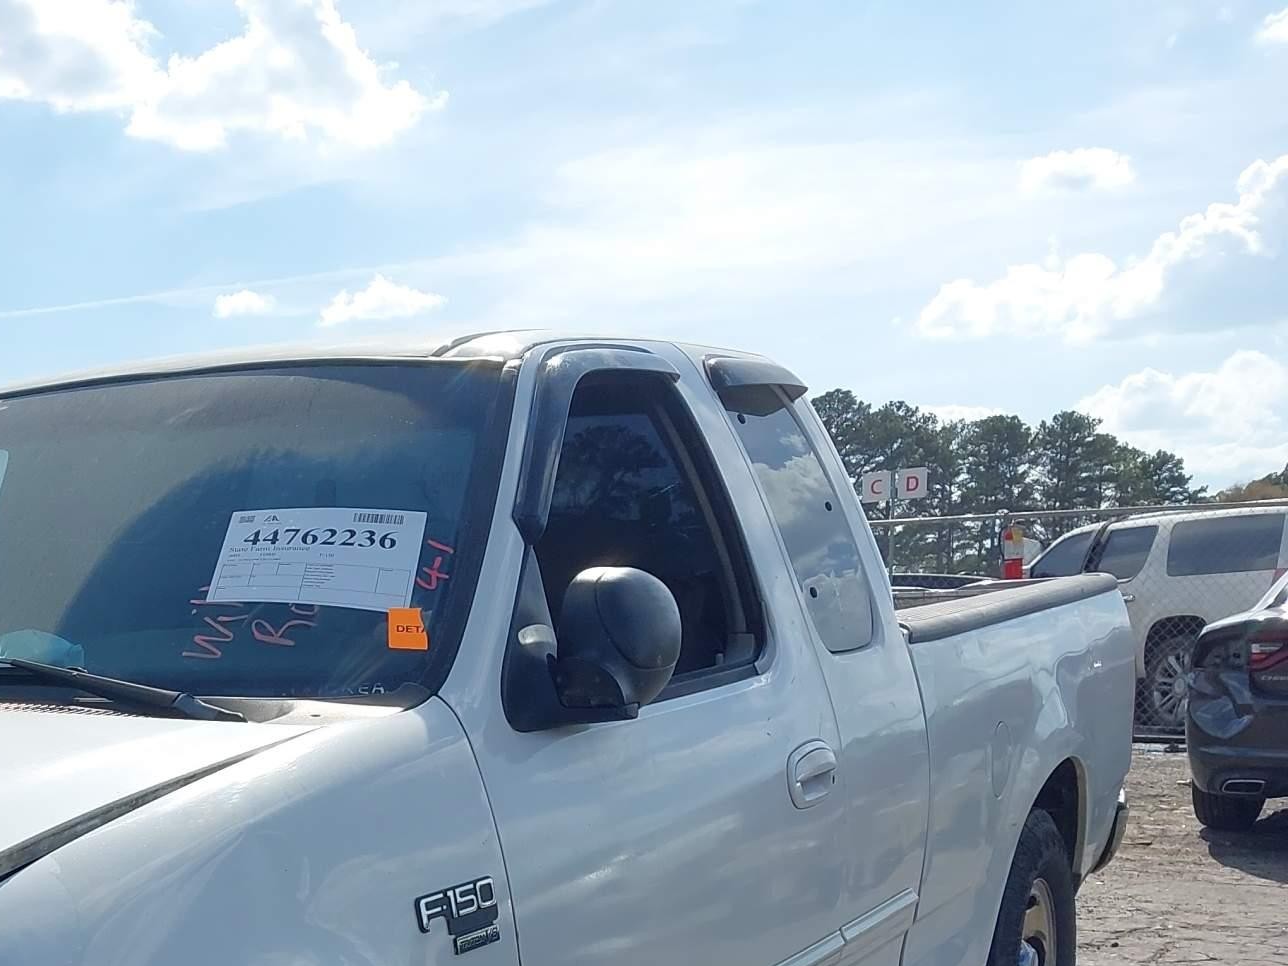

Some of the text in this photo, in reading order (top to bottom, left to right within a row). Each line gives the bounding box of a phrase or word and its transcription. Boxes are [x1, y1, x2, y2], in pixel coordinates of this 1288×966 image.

[870, 479, 883, 494] C
[906, 475, 919, 492] D
[243, 528, 400, 549] 44762236
